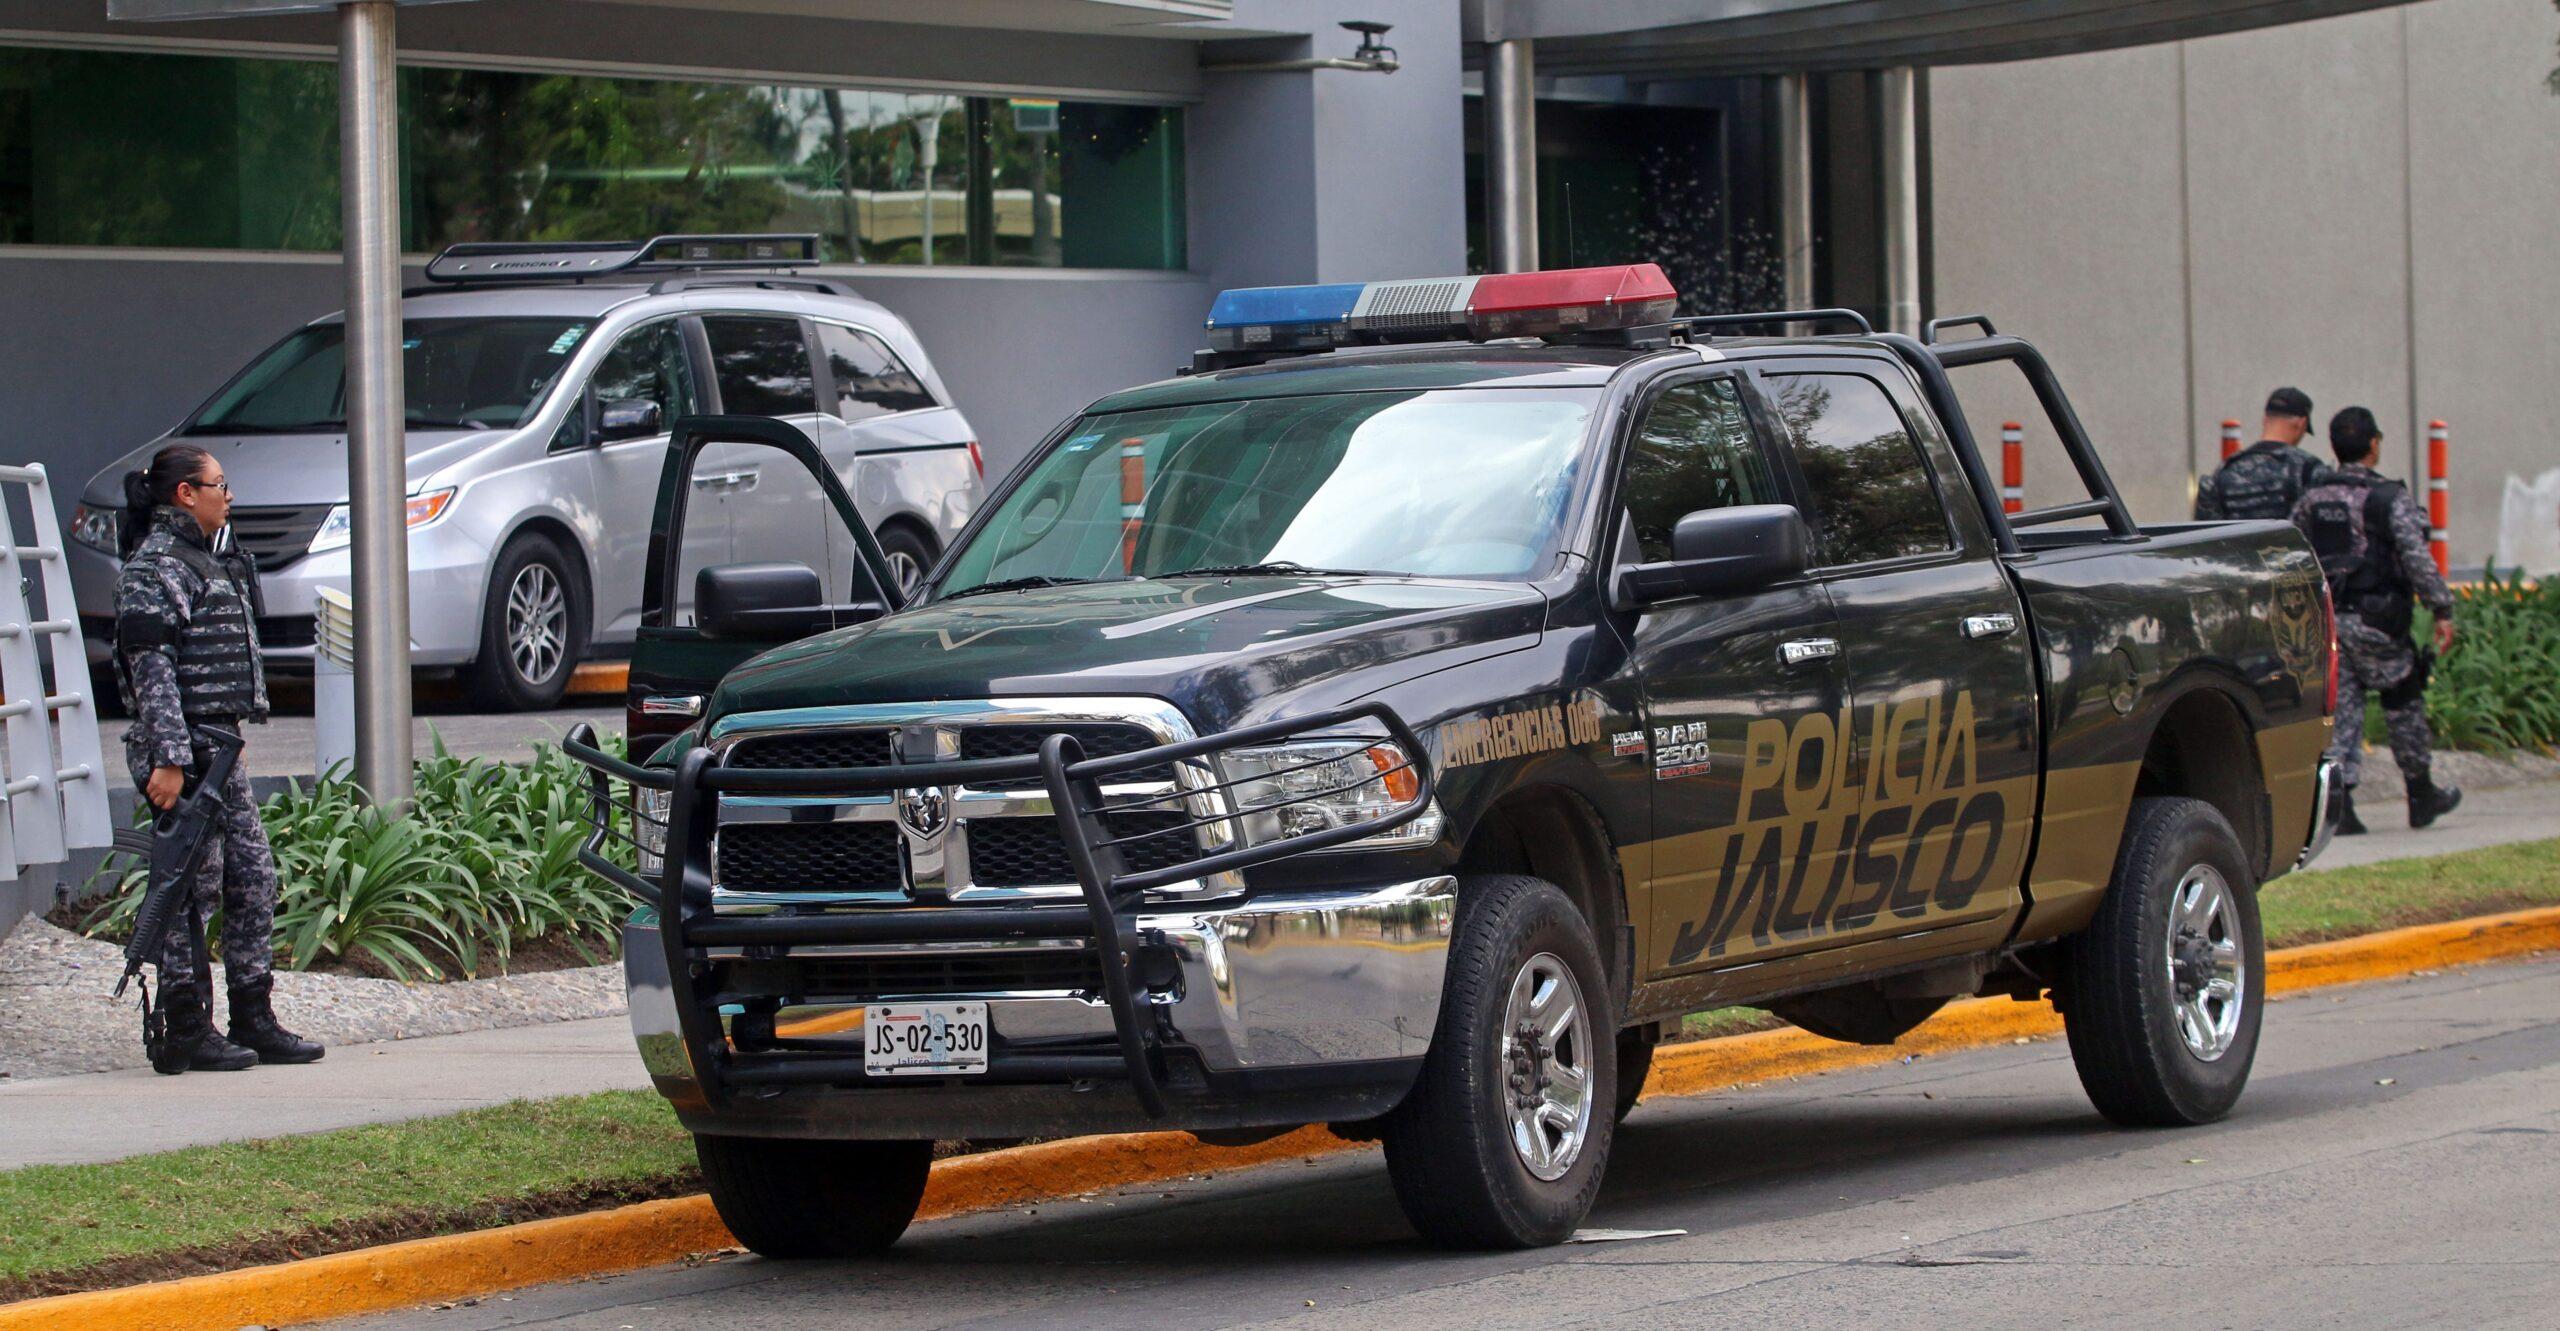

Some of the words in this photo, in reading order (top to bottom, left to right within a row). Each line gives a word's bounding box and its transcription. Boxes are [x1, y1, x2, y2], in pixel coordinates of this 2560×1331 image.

[1442, 705, 1566, 768] EMERGENCIAS
[1654, 721, 1708, 745] RAM
[1656, 741, 1710, 766] 2500
[1736, 690, 1977, 826] POLICIA
[1660, 767, 1685, 778] HEAVY
[1686, 763, 1709, 773] DUTY
[1668, 791, 2006, 967] JALISCO
[870, 1023, 983, 1054] JS-02-530
